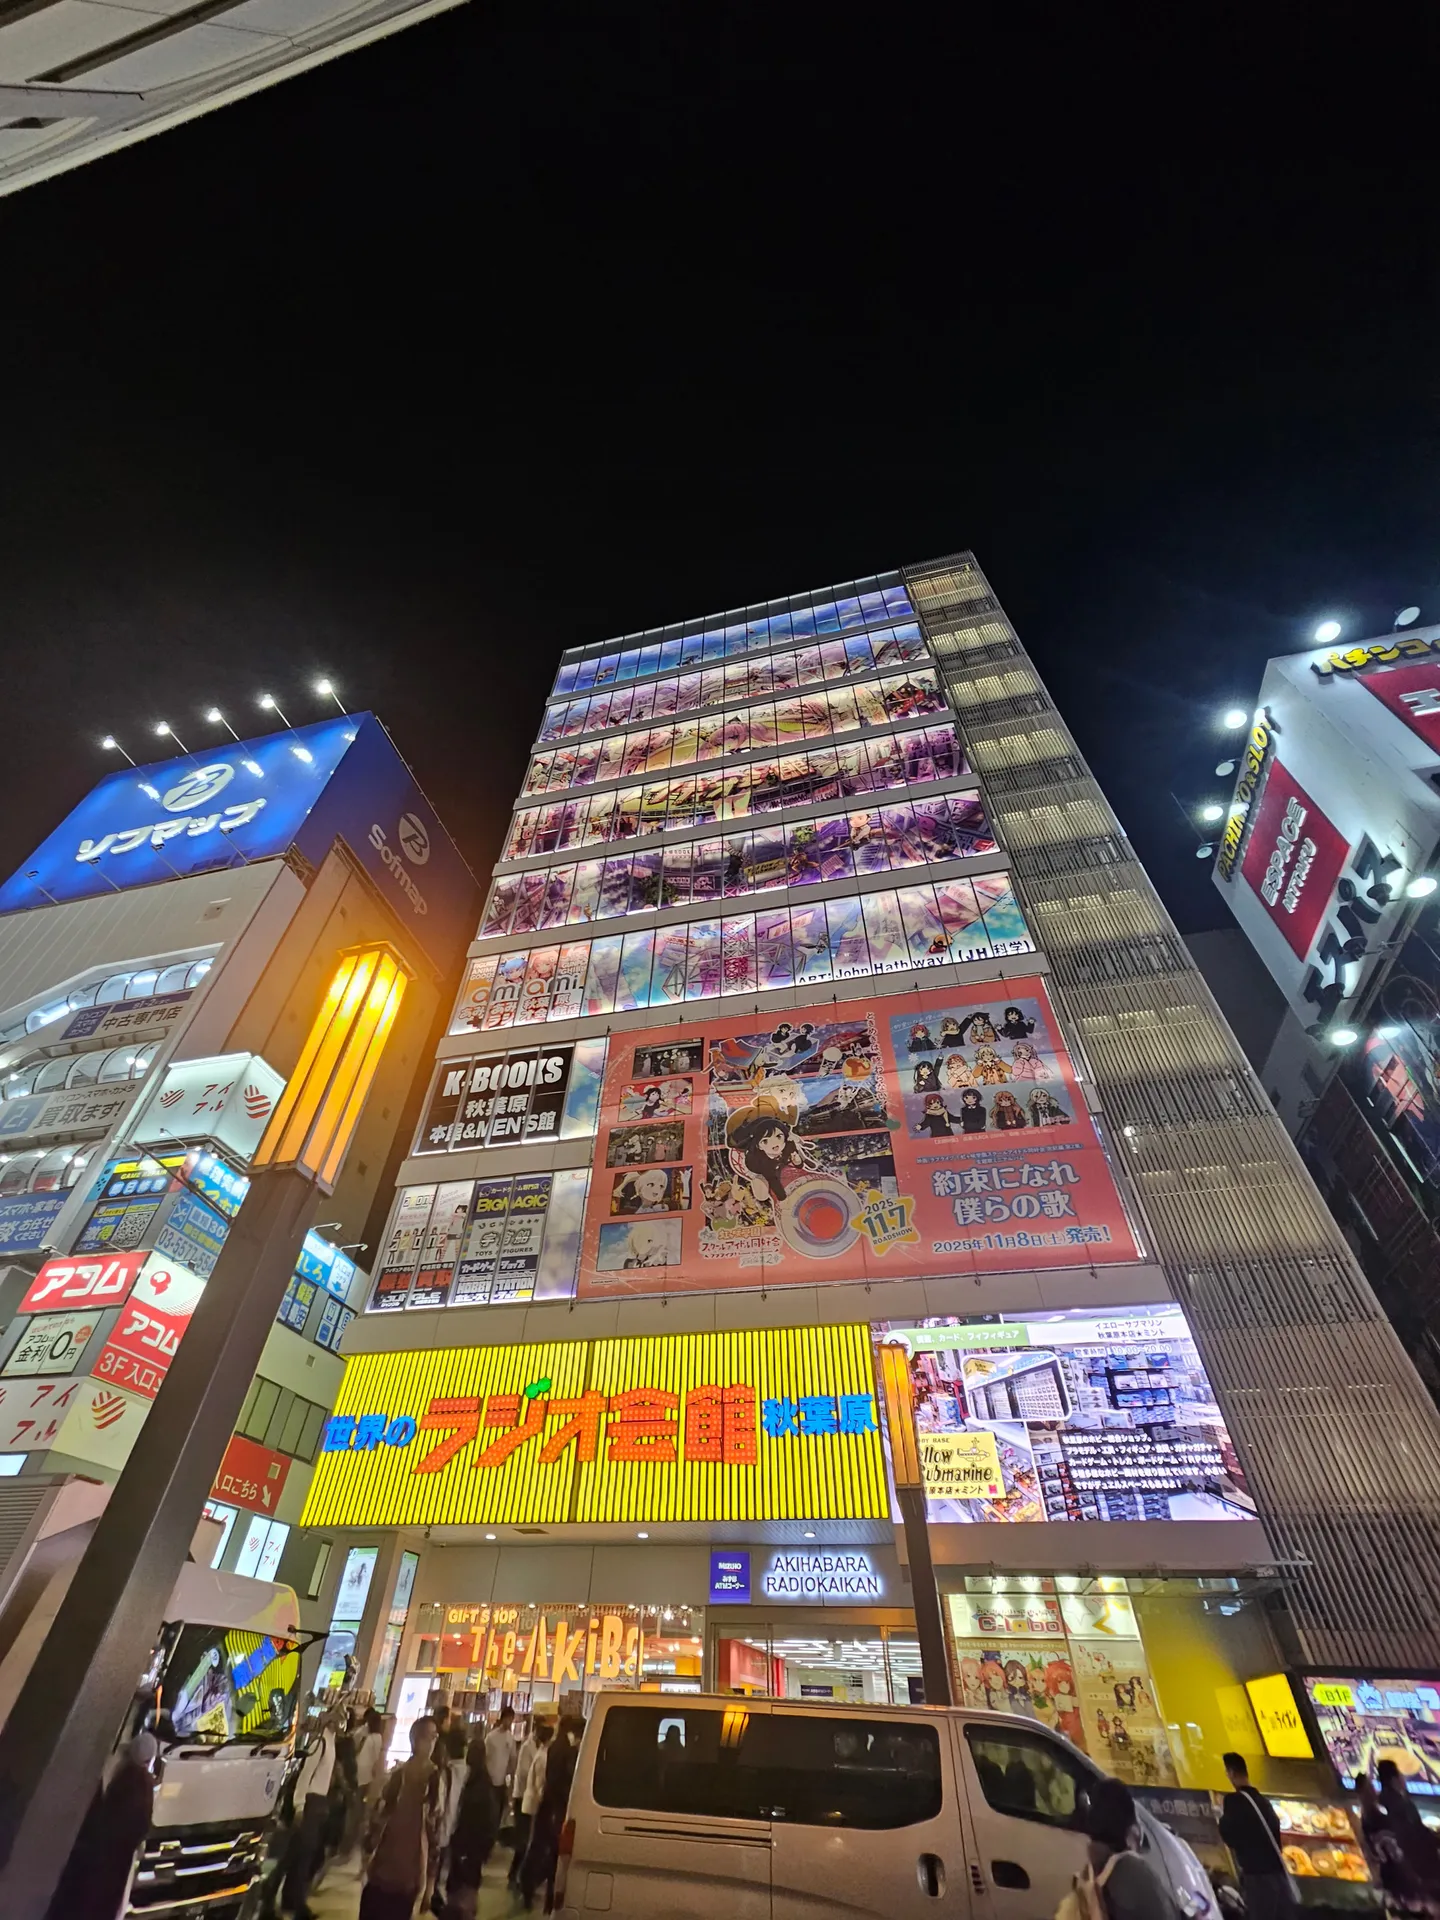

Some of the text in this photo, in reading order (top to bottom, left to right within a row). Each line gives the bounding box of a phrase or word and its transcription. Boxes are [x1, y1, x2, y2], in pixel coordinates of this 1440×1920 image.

[76, 798, 267, 863] ソフマップ
[1260, 796, 1309, 907] ESPACE
[368, 823, 428, 915] Sofmap
[101, 1006, 183, 1030] 中古専門店
[442, 1056, 564, 1097] K-BOOKS
[465, 1093, 530, 1118] 秋葉原
[932, 1160, 1081, 1197] 約束になれ
[953, 1190, 1077, 1226] 僕らの歌
[863, 1205, 907, 1239] 11.7
[872, 1227, 914, 1246] ROADSHOW
[31, 1262, 129, 1302] アコム
[496, 1278, 534, 1291] TATION
[122, 1310, 179, 1357] アコム
[1095, 1319, 1163, 1330] イエローサブマリン
[100, 1351, 128, 1376] 3F
[323, 1378, 879, 1474] 世界の ラジオ会館 秋葉原
[922, 1446, 953, 1464] llow
[927, 1486, 984, 1495] 原本店★ミント
[718, 1562, 742, 1570] MIZUHO
[773, 1556, 869, 1573] AKIHABARA
[766, 1576, 878, 1594] RADIOKAIKAN
[448, 1608, 479, 1624] GIFT
[471, 1626, 516, 1668] The
